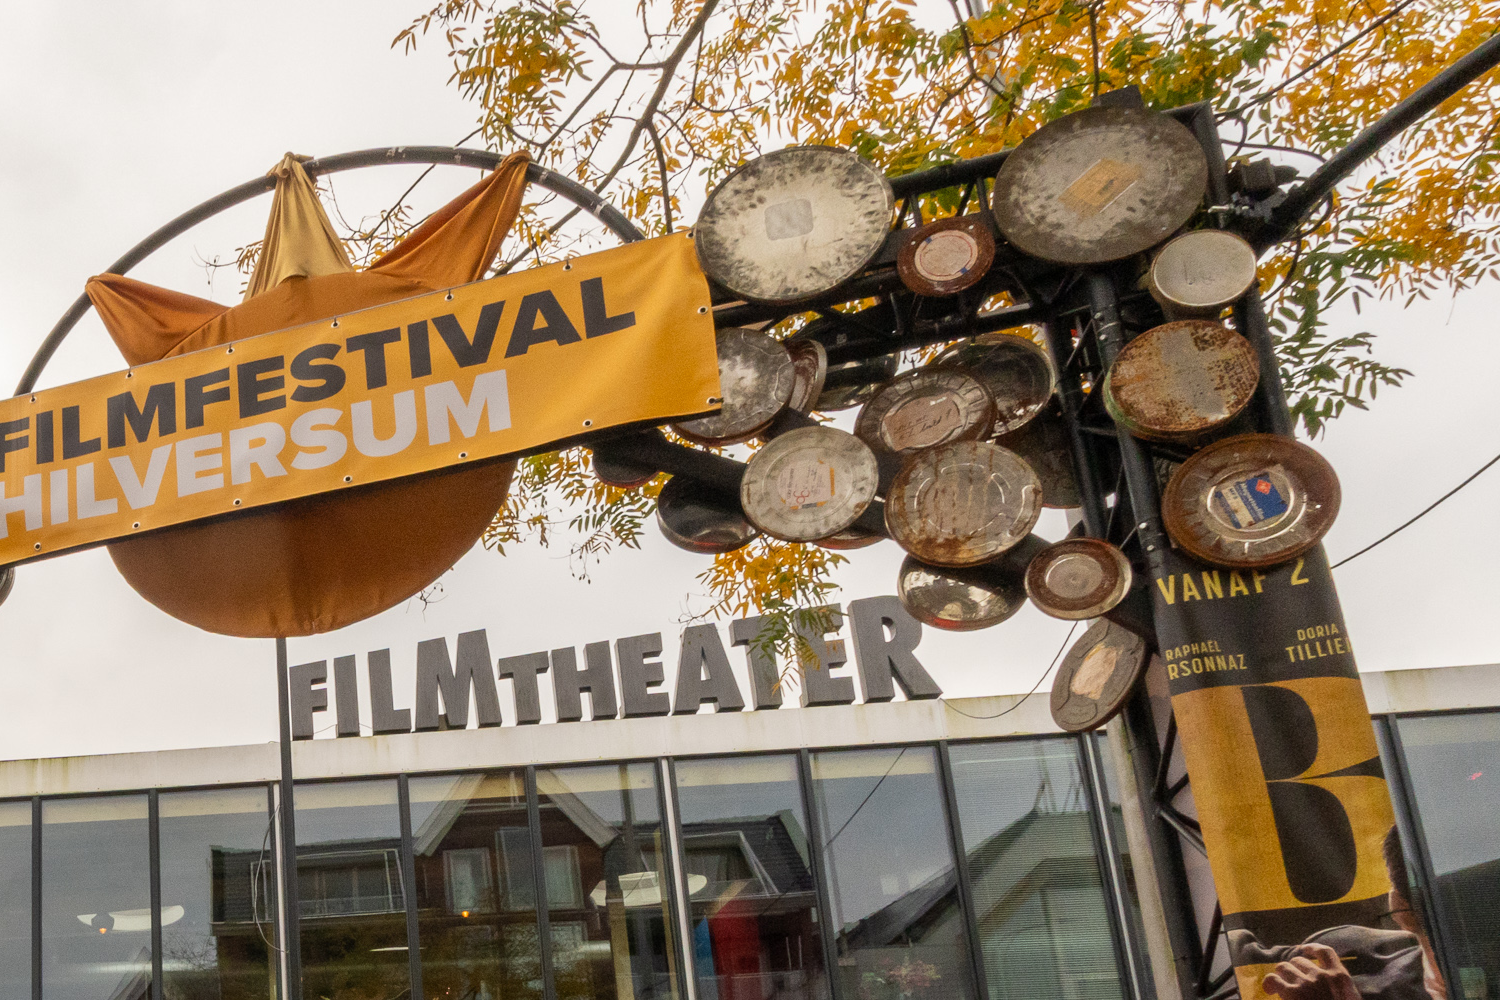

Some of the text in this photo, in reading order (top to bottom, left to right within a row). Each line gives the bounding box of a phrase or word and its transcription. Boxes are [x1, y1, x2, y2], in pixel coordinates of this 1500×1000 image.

[1156, 569, 1265, 605] VANAF
[1296, 623, 1339, 641] DORIA
[1166, 640, 1222, 661] RAPHAEL
[289, 595, 944, 741] FILMTHEATER
[1168, 654, 1248, 680] RSONNAZ
